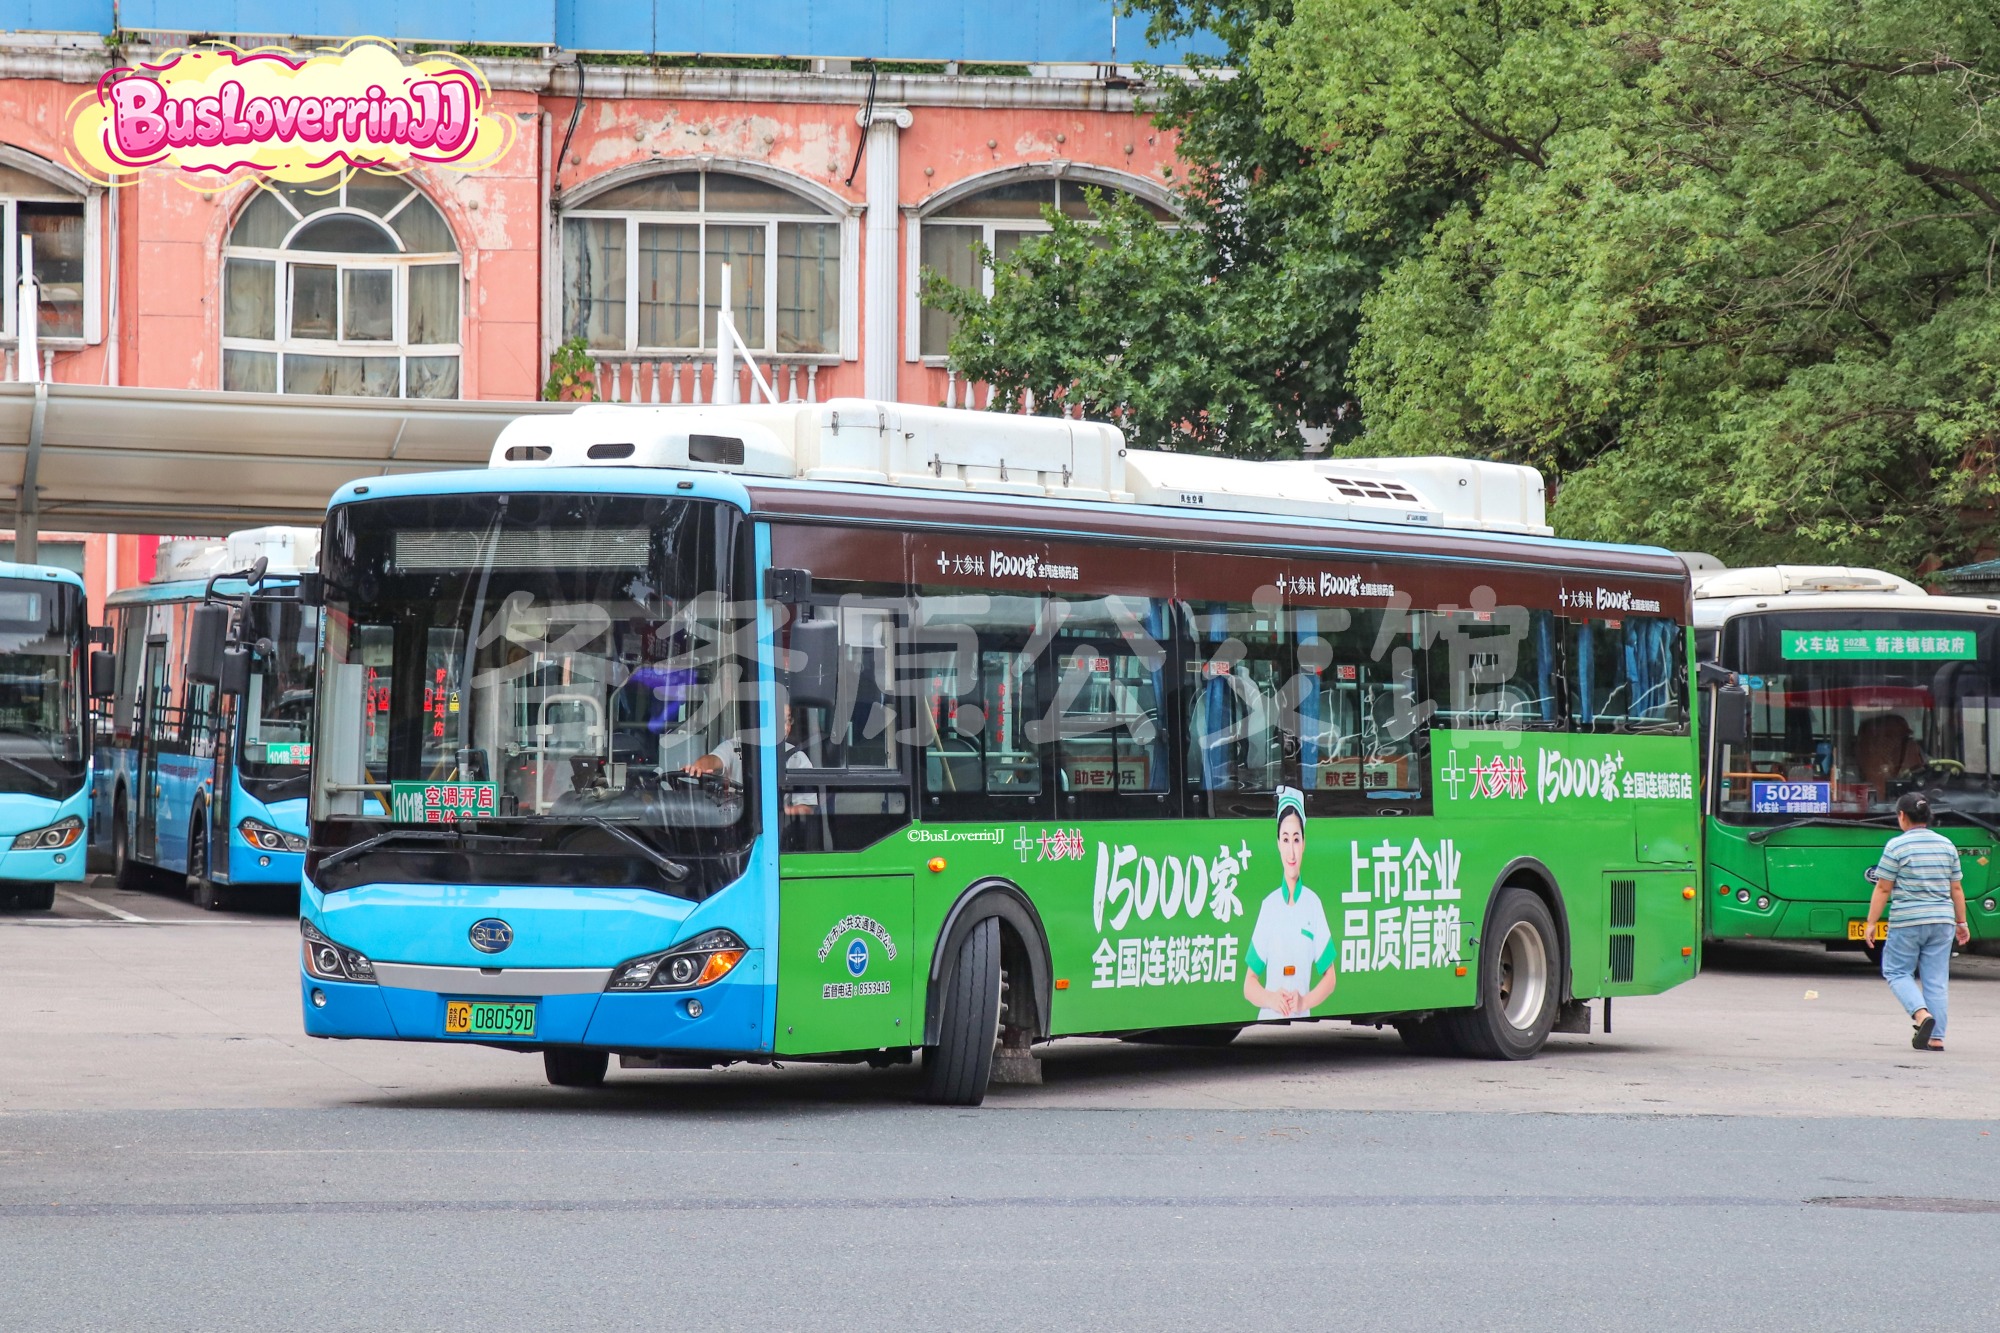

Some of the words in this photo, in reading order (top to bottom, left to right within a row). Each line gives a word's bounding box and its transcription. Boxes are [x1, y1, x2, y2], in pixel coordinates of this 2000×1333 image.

[952, 554, 985, 576] 大参林
[1038, 563, 1079, 580] 全国连锁药店
[1289, 576, 1316, 595] 大参林
[1570, 590, 1593, 609] 大参林
[1795, 637, 1840, 653] 火车站
[1875, 637, 1965, 653] 新港镇镇政府
[1469, 754, 1527, 800] 大参林
[1622, 771, 1692, 800] 全国连锁药店
[395, 792, 423, 822] 101路
[425, 786, 494, 808] 空调开启
[1766, 785, 1817, 800] 502路
[1036, 827, 1086, 862] 大参林
[1341, 837, 1462, 904] 上市企业
[818, 914, 897, 963] 九江市公共交通集团公司
[1341, 904, 1461, 973] 品质信赖
[1091, 933, 1239, 989] 全国连锁药店
